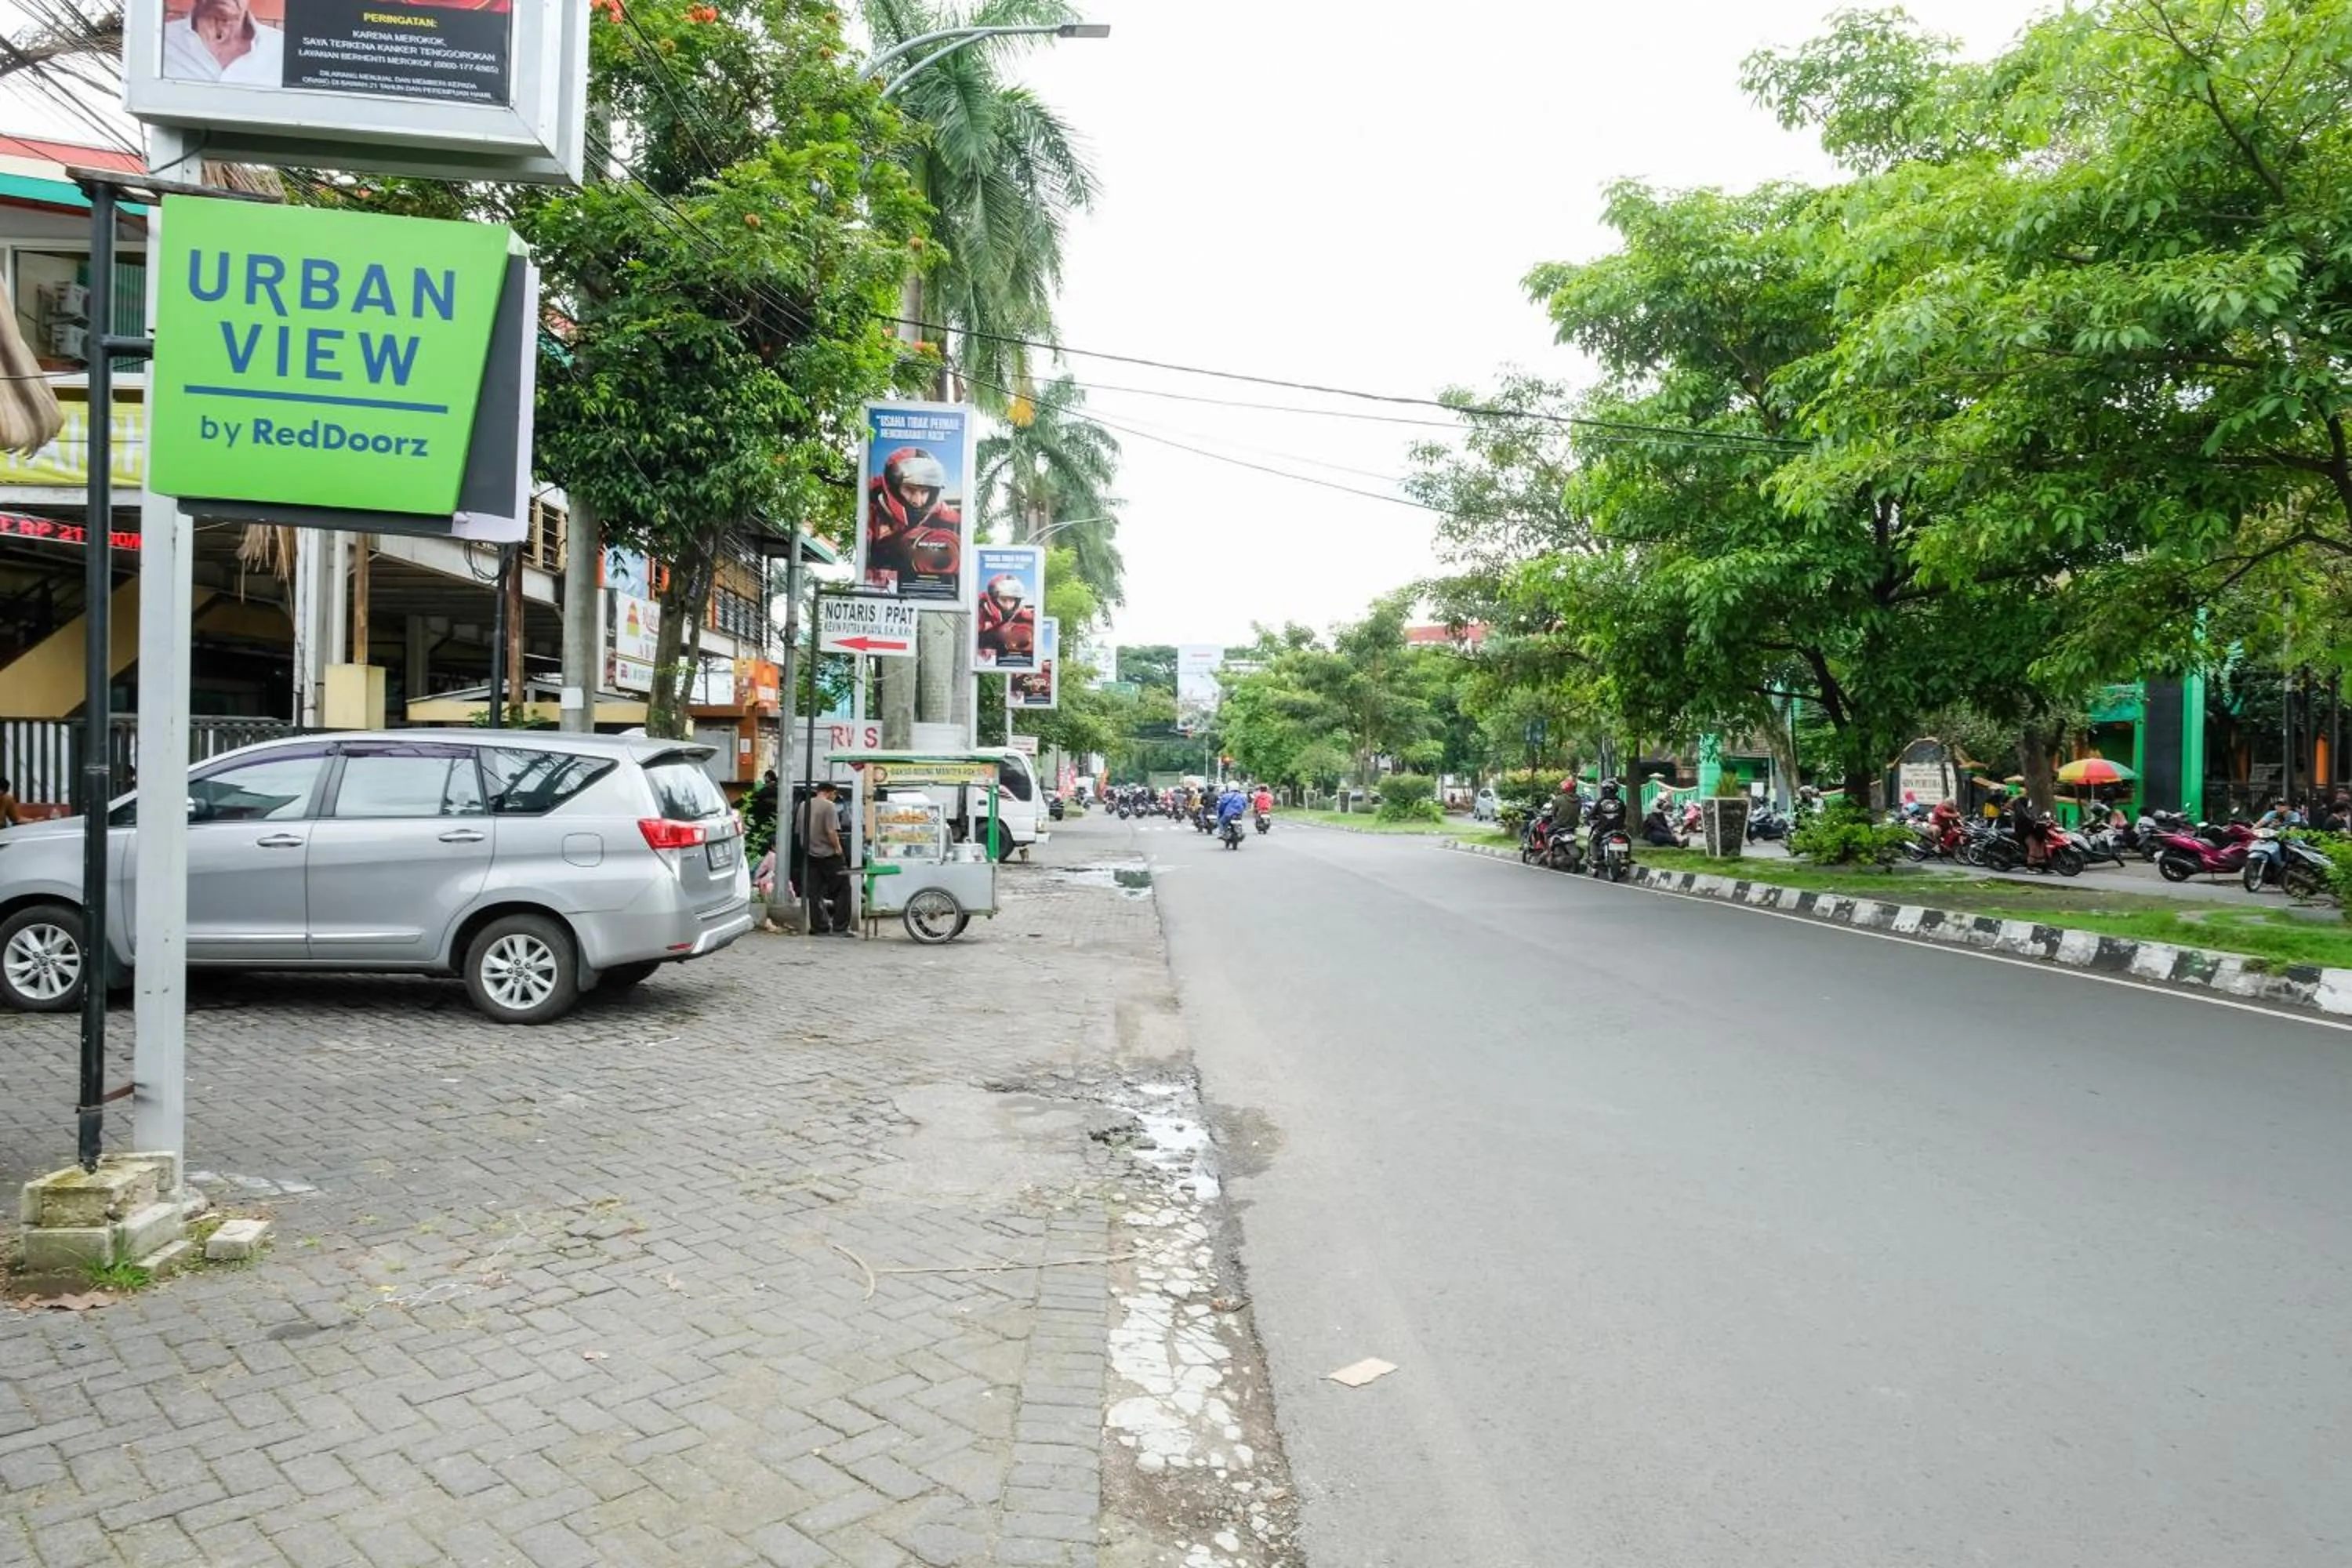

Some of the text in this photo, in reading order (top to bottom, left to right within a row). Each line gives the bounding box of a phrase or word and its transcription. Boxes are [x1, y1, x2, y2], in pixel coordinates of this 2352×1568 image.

[363, 12, 437, 27] PERINGATAN:
[352, 30, 394, 42] KARENA
[298, 49, 339, 60] LAYANAN
[340, 53, 386, 64] BERHENTI
[387, 56, 431, 67] MEROKOK
[302, 37, 495, 62] SAYA TERKENA KANKER TENGGOROKAN
[188, 249, 456, 321] URBAN
[220, 321, 421, 387] VIEW
[200, 416, 430, 457] by RedDoorz
[826, 601, 876, 622] NOTARIS
[886, 605, 915, 625] PPAT
